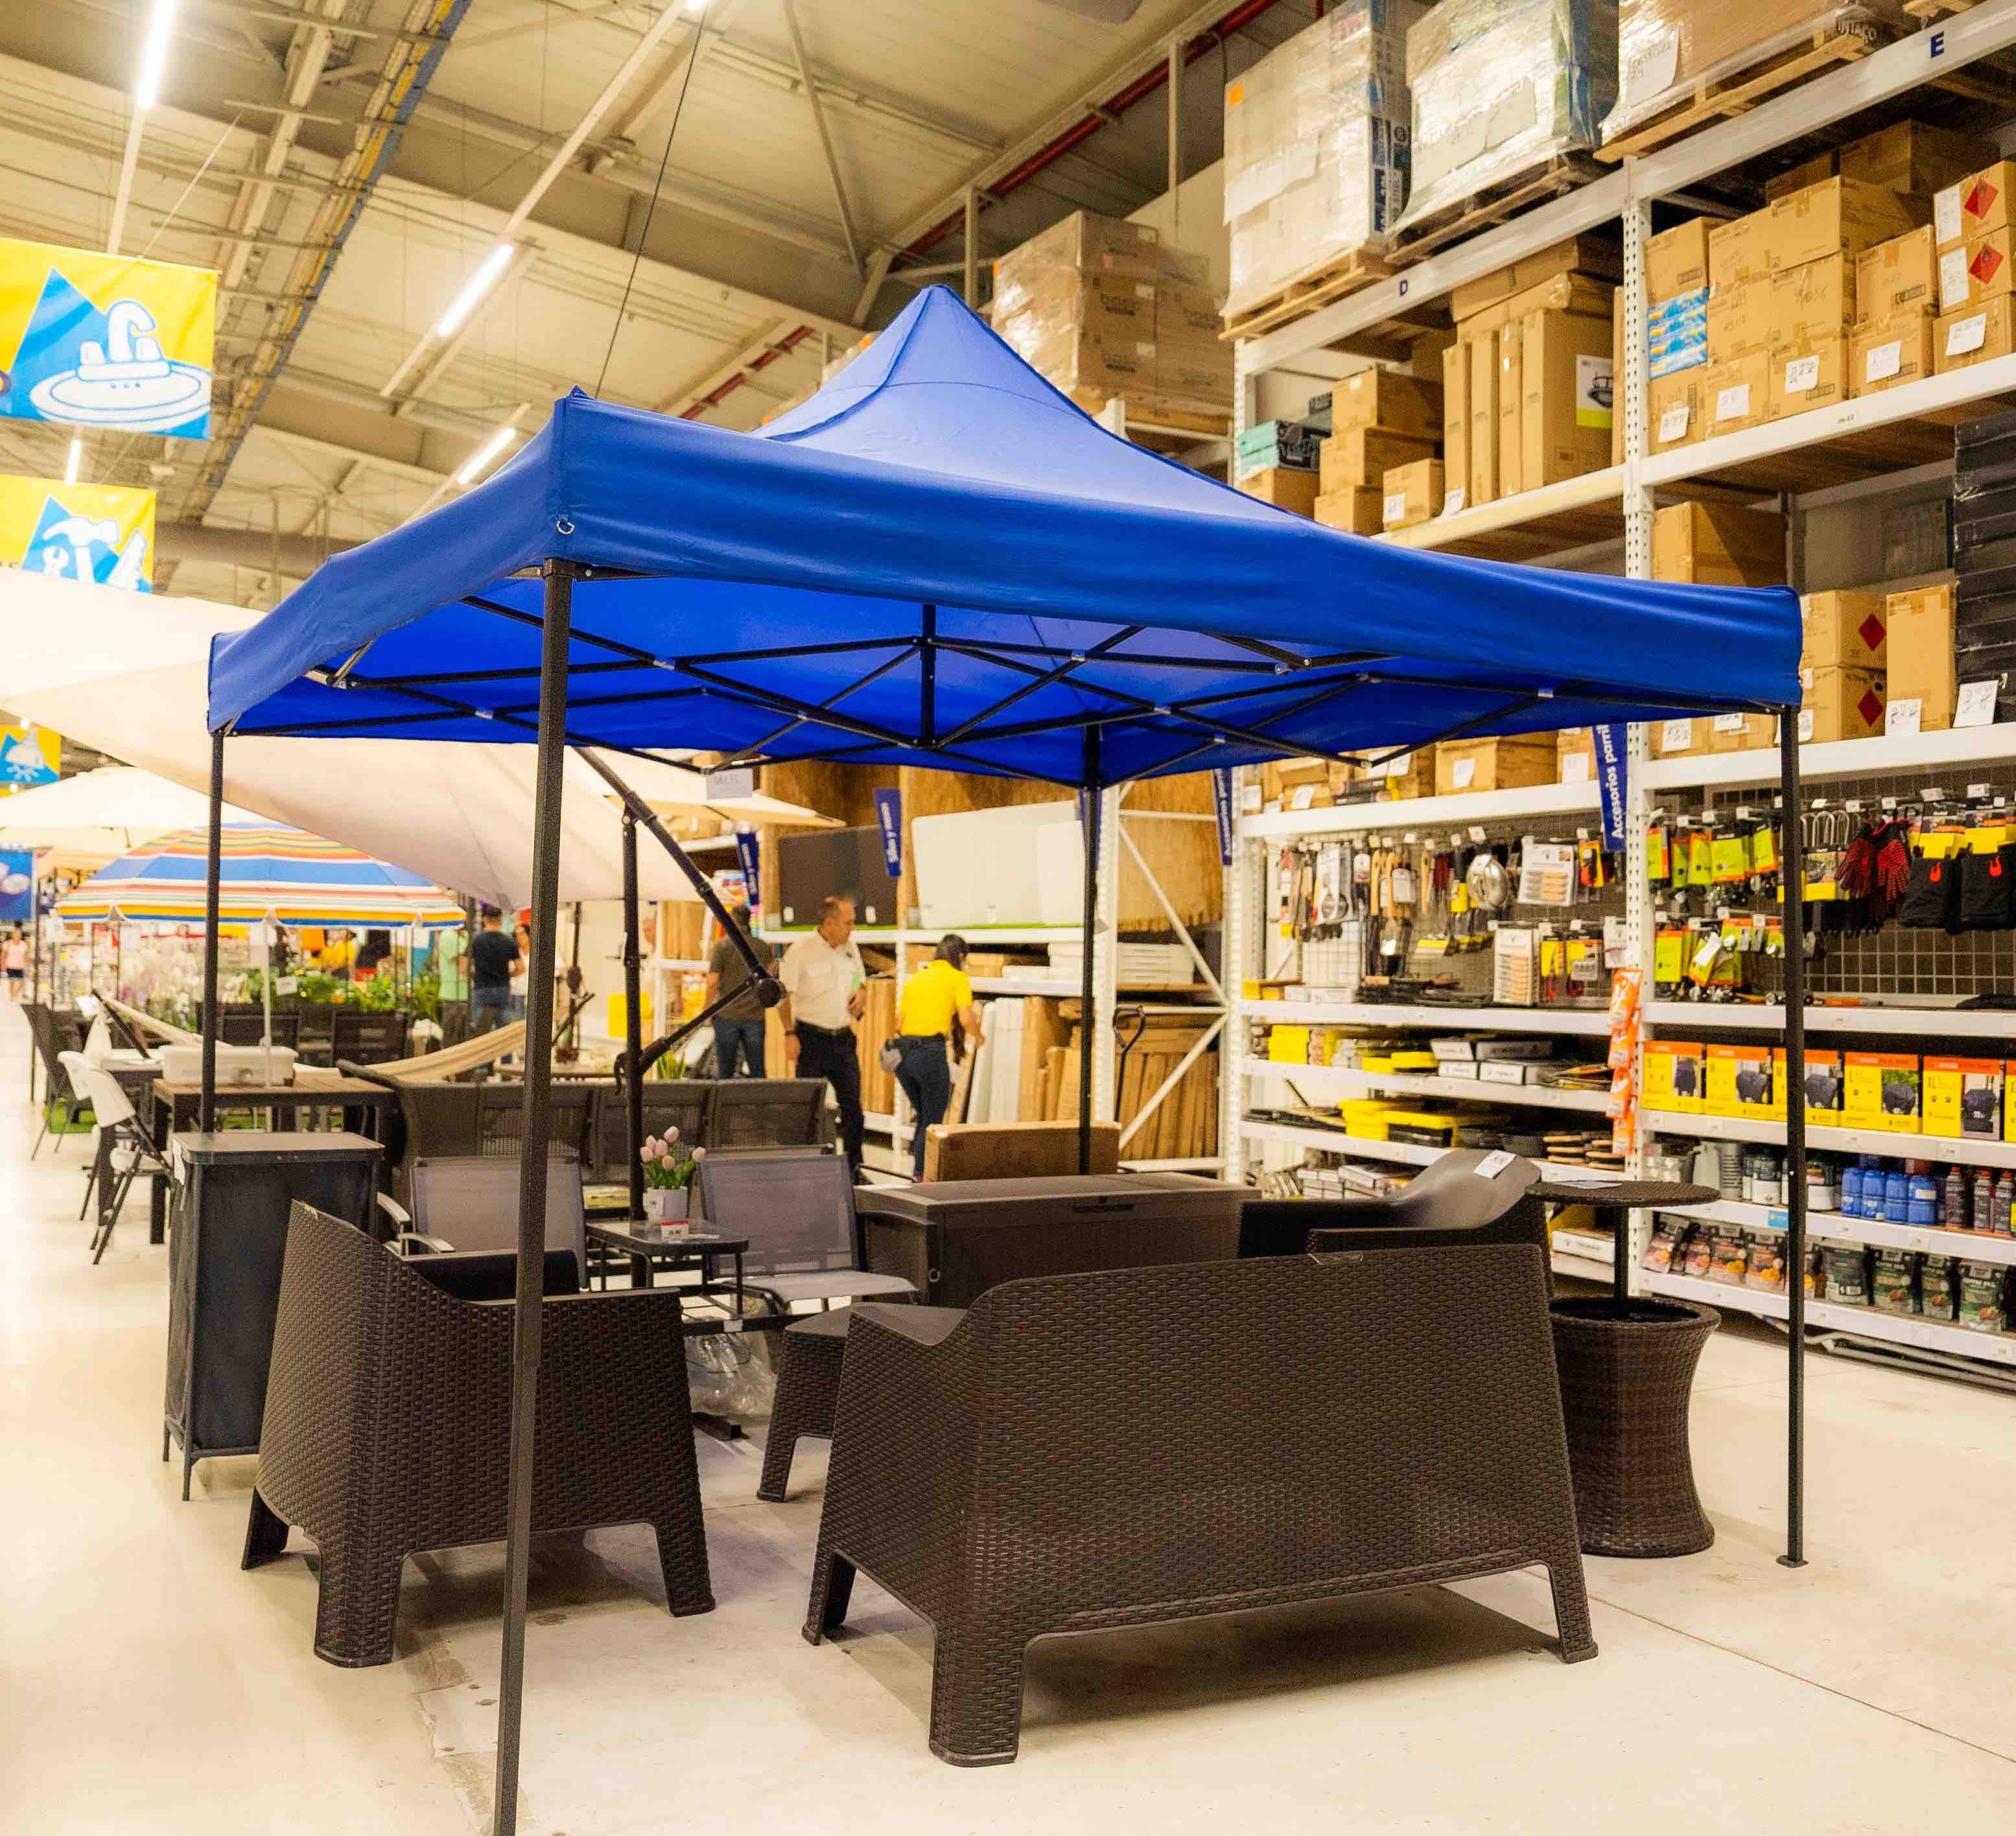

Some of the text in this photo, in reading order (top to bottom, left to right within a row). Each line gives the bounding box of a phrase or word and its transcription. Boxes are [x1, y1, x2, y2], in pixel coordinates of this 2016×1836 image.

[1930, 31, 1945, 58] E
[1400, 279, 1409, 297] D
[1606, 766, 1624, 839] Accesorios
